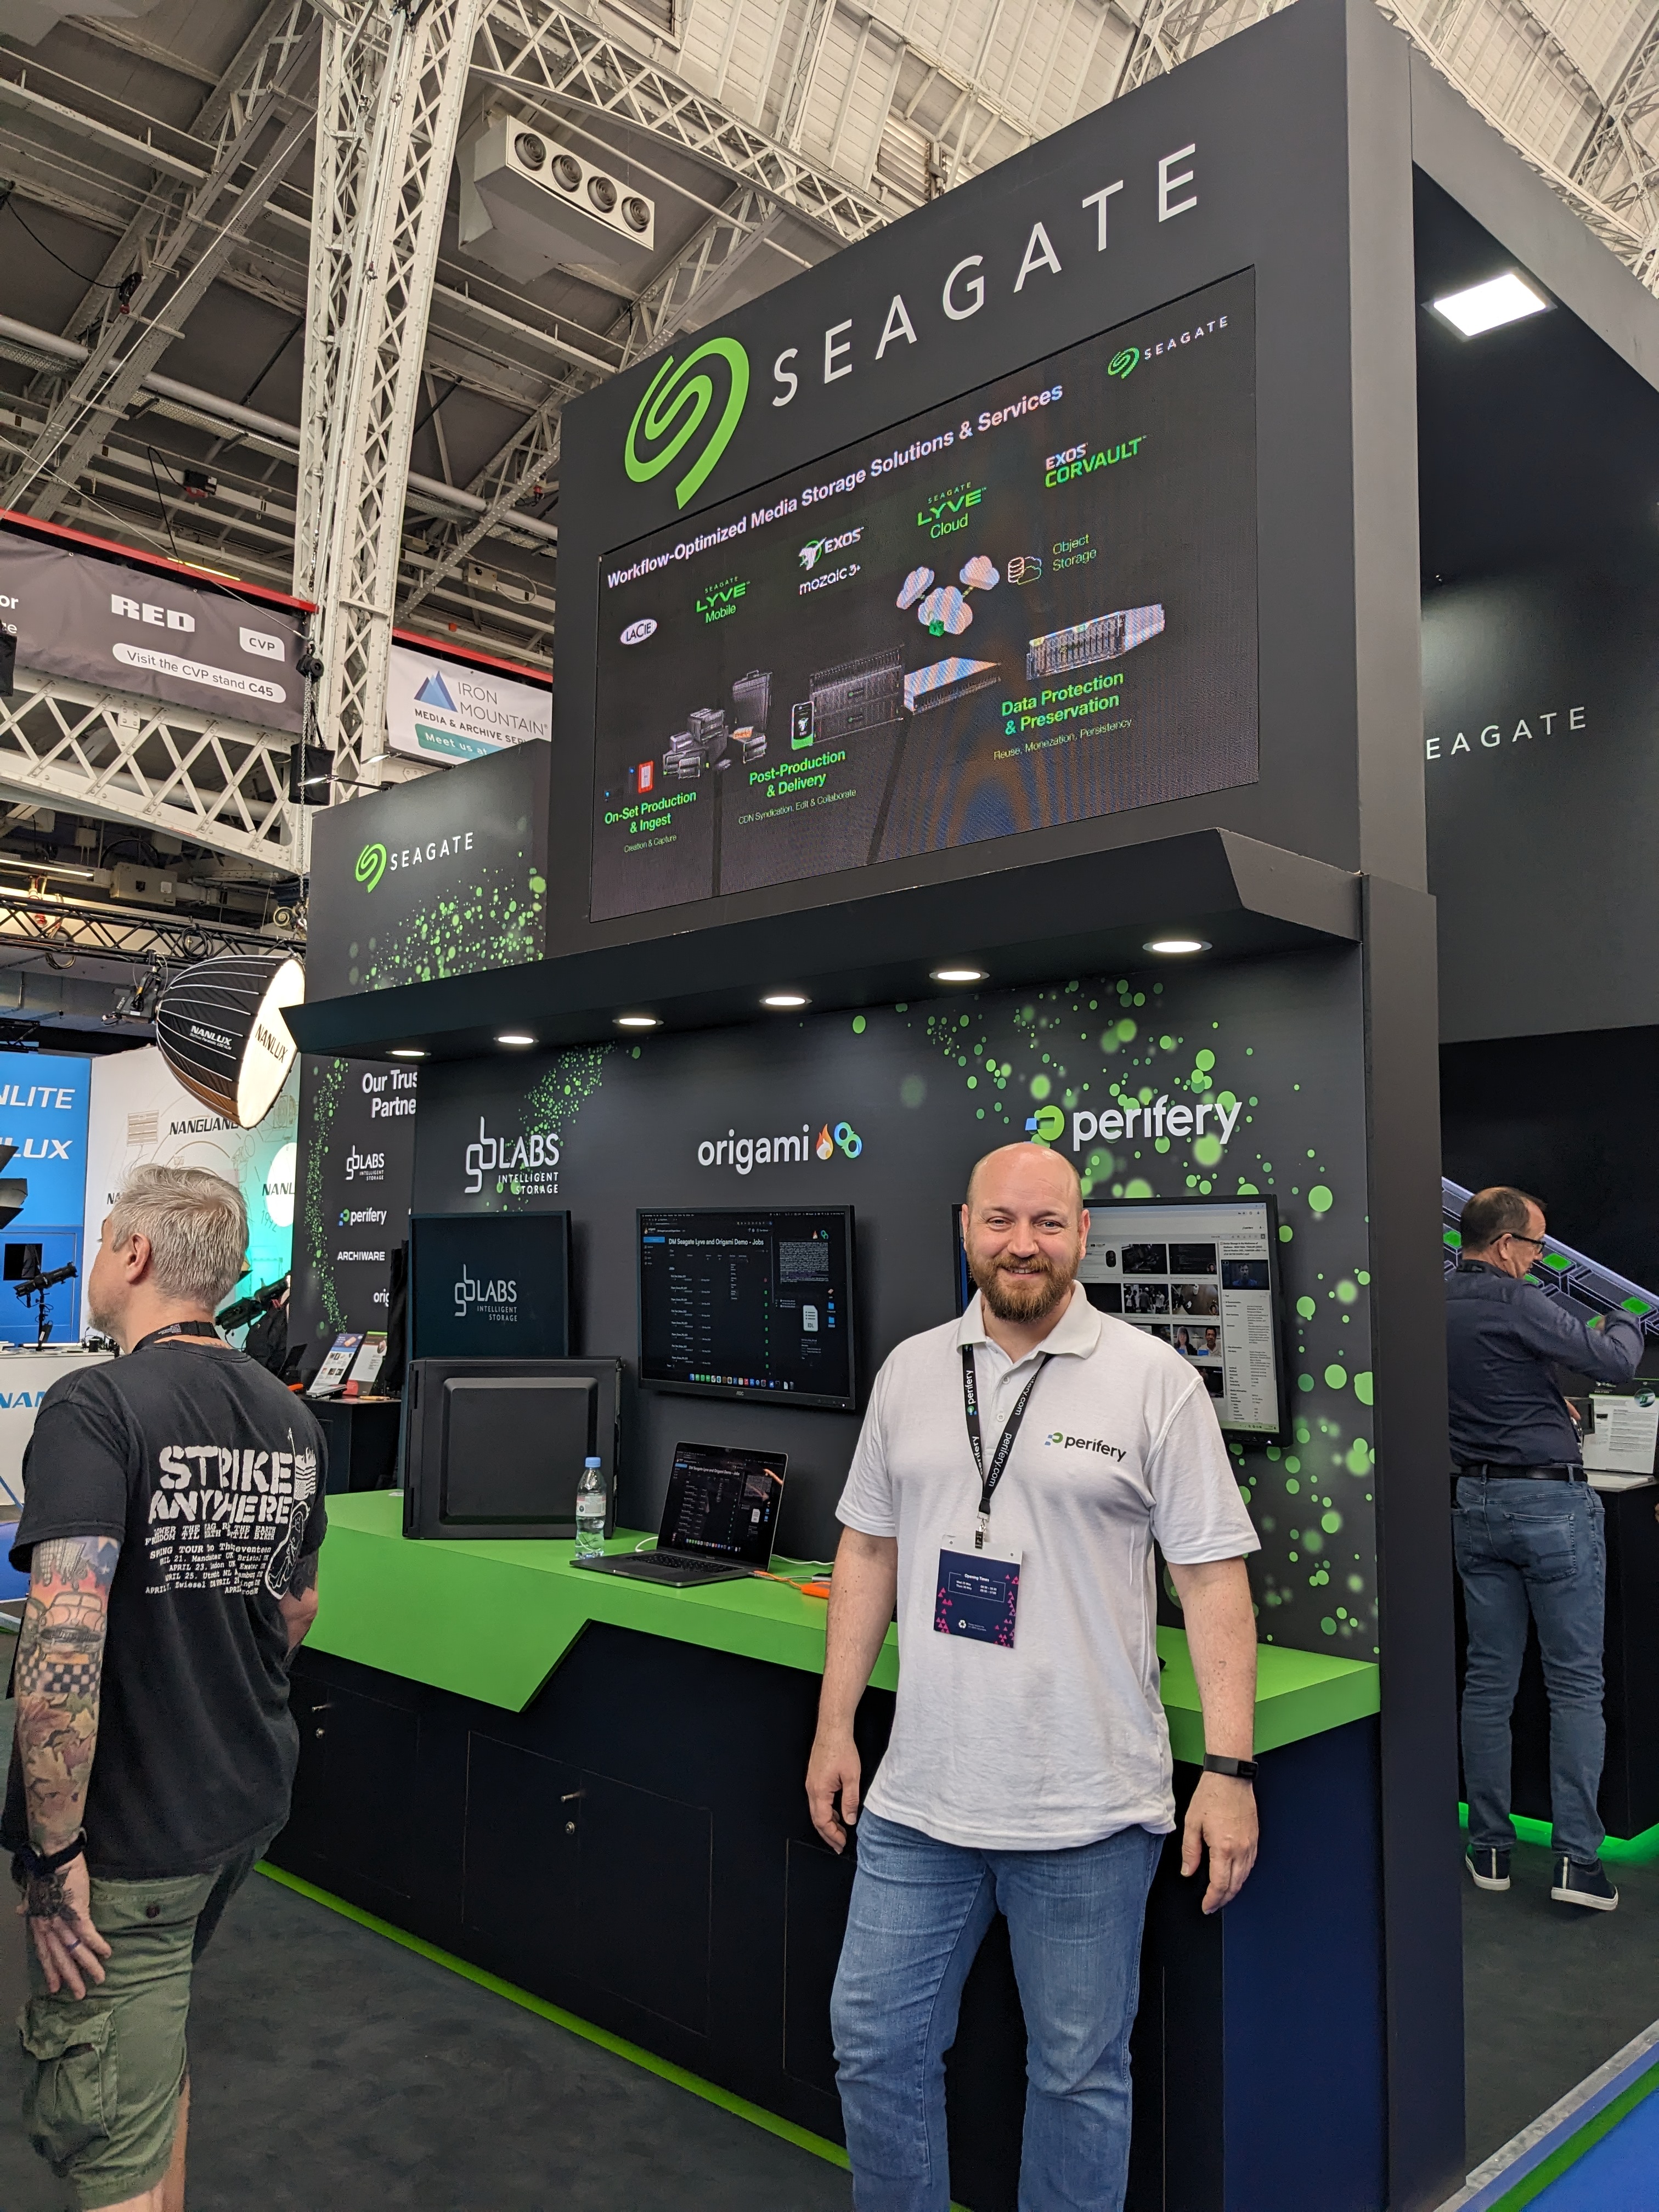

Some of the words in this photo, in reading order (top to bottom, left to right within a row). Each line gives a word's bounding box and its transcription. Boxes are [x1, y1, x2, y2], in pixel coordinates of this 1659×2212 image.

[771, 143, 1198, 407] SEAGATE
[1144, 316, 1229, 360] SEAGATE
[1045, 442, 1087, 471] EXOS
[1045, 436, 1142, 488] CORVAULT
[607, 516, 747, 589] Workflow-Optimized
[751, 497, 798, 529] Media
[801, 469, 866, 507] Storage
[870, 431, 954, 477] Solutions
[959, 420, 974, 440] &
[977, 384, 1063, 432] Services
[928, 482, 972, 504] SEAGATE
[917, 488, 982, 527] LYVE
[930, 512, 969, 539] Cloud
[825, 528, 861, 554] EXOS
[1053, 533, 1090, 555] Object
[1053, 548, 1098, 572] Storage
[704, 575, 738, 594] SEAGATE
[799, 567, 848, 595] mozaic
[696, 582, 746, 613] LYVE
[111, 594, 195, 633] RED
[705, 604, 736, 623] Mobile
[249, 637, 275, 651] CVP
[127, 650, 156, 666] Visit
[159, 658, 178, 672] the
[182, 665, 209, 679] CVP
[212, 674, 245, 690] stand
[249, 682, 274, 697] C45
[458, 681, 498, 705] IRON
[1001, 697, 1037, 716] Data
[1041, 672, 1125, 707] Protection
[415, 708, 447, 725] MEDIA
[449, 719, 456, 728] &
[459, 722, 503, 741] ARCHIVE
[1005, 720, 1017, 736] &
[1020, 693, 1120, 732] Preservation
[425, 732, 455, 748] Meet
[460, 743, 473, 752] us
[476, 746, 488, 755] at
[1426, 706, 1586, 760] EAGATE
[749, 748, 847, 786] Post-Production
[766, 784, 775, 798] &
[778, 773, 826, 795] Delivery
[605, 805, 639, 825] On-Set
[640, 789, 697, 815] Production
[795, 801, 809, 811] Edit
[810, 798, 816, 806] &
[817, 789, 857, 805] Collaborate
[630, 821, 638, 833] &
[640, 811, 672, 831] Ingest
[390, 831, 473, 871] SEAGATE
[624, 842, 647, 853] Creation
[653, 834, 677, 845] Capture
[190, 1025, 233, 1046] NANLUX
[255, 1023, 288, 1063] NANLUX
[362, 1073, 388, 1093] Our
[390, 1069, 418, 1090] Trus
[371, 1096, 416, 1119] Partne
[1073, 1094, 1243, 1152] perifery
[697, 1124, 809, 1175] origami
[262, 1182, 295, 1197] NANL
[498, 1171, 559, 1184] INTELLIGENT
[516, 1183, 559, 1195] STORAGE
[350, 1207, 387, 1226] perifery
[677, 1238, 695, 1246] Seagate
[695, 1238, 706, 1246] Lyve
[715, 1238, 733, 1246] Origami
[337, 1251, 386, 1261] ARCHIWARE
[476, 1305, 517, 1313] INTELLIGENT
[489, 1313, 517, 1322] STORAGE
[964, 1369, 977, 1405] perifery
[988, 1432, 1013, 1488] perifery.com
[1064, 1435, 1127, 1463] perifery
[159, 1444, 293, 1494] STRIKE
[181, 1532, 200, 1541] TIL
[253, 1532, 275, 1541] BIRTH
[182, 1524, 201, 1533] THE
[234, 1525, 251, 1533] THE
[255, 1525, 276, 1533] EARTH
[174, 1554, 187, 1562] 21.
[237, 1554, 262, 1562] Bristol
[178, 1545, 204, 1554] TOUR
[169, 1564, 191, 1572] APRIL
[224, 1585, 242, 1594] APRIL
